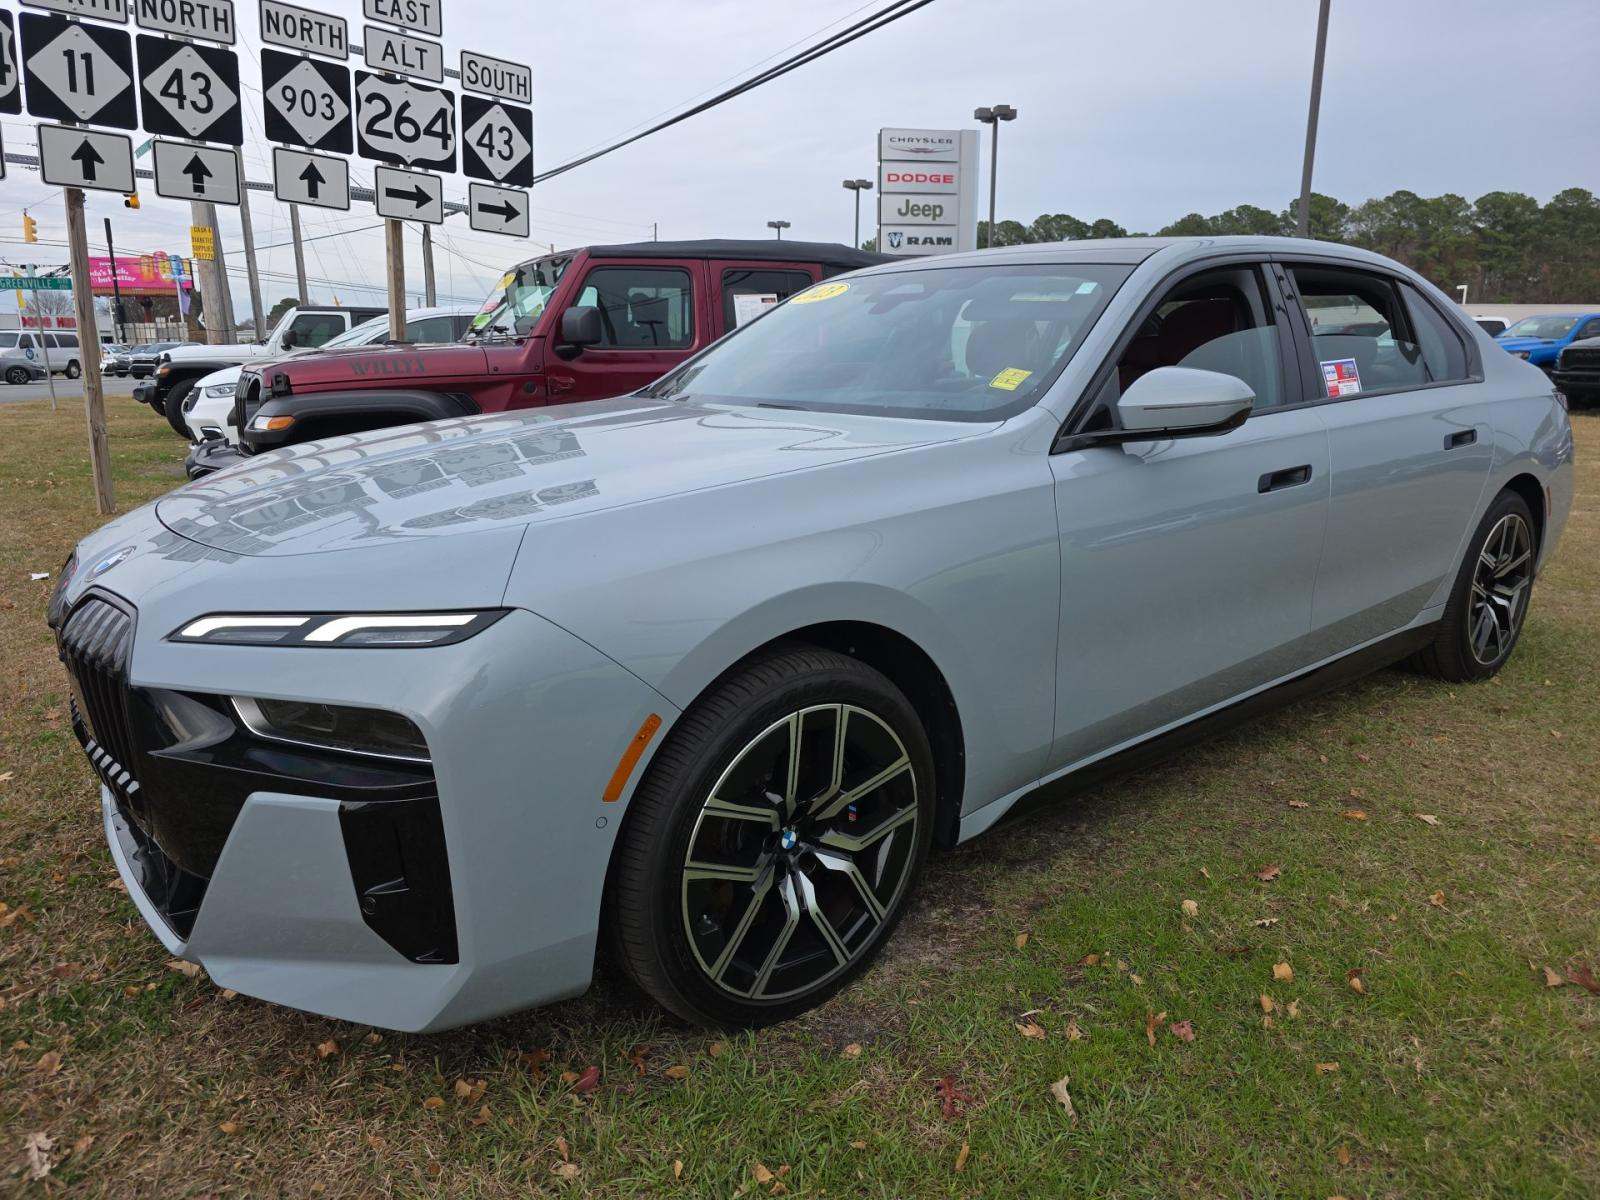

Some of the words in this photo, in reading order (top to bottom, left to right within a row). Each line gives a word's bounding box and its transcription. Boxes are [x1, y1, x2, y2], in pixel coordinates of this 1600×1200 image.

[142, 0, 229, 34] NORTH
[265, 9, 343, 50] NORTH
[375, 0, 431, 27] EAST
[63, 49, 95, 96] 11
[381, 40, 428, 71] ALT
[160, 68, 214, 114] 43
[466, 59, 527, 97] SOUTH
[281, 85, 336, 121] 903
[364, 92, 452, 151] 264
[476, 122, 514, 161] 43
[889, 137, 953, 145] CHRYSLER
[888, 174, 954, 184] DODGE
[897, 199, 944, 221] Jeep
[907, 236, 953, 246] RAM
[0, 278, 52, 289] GREENVILLE
